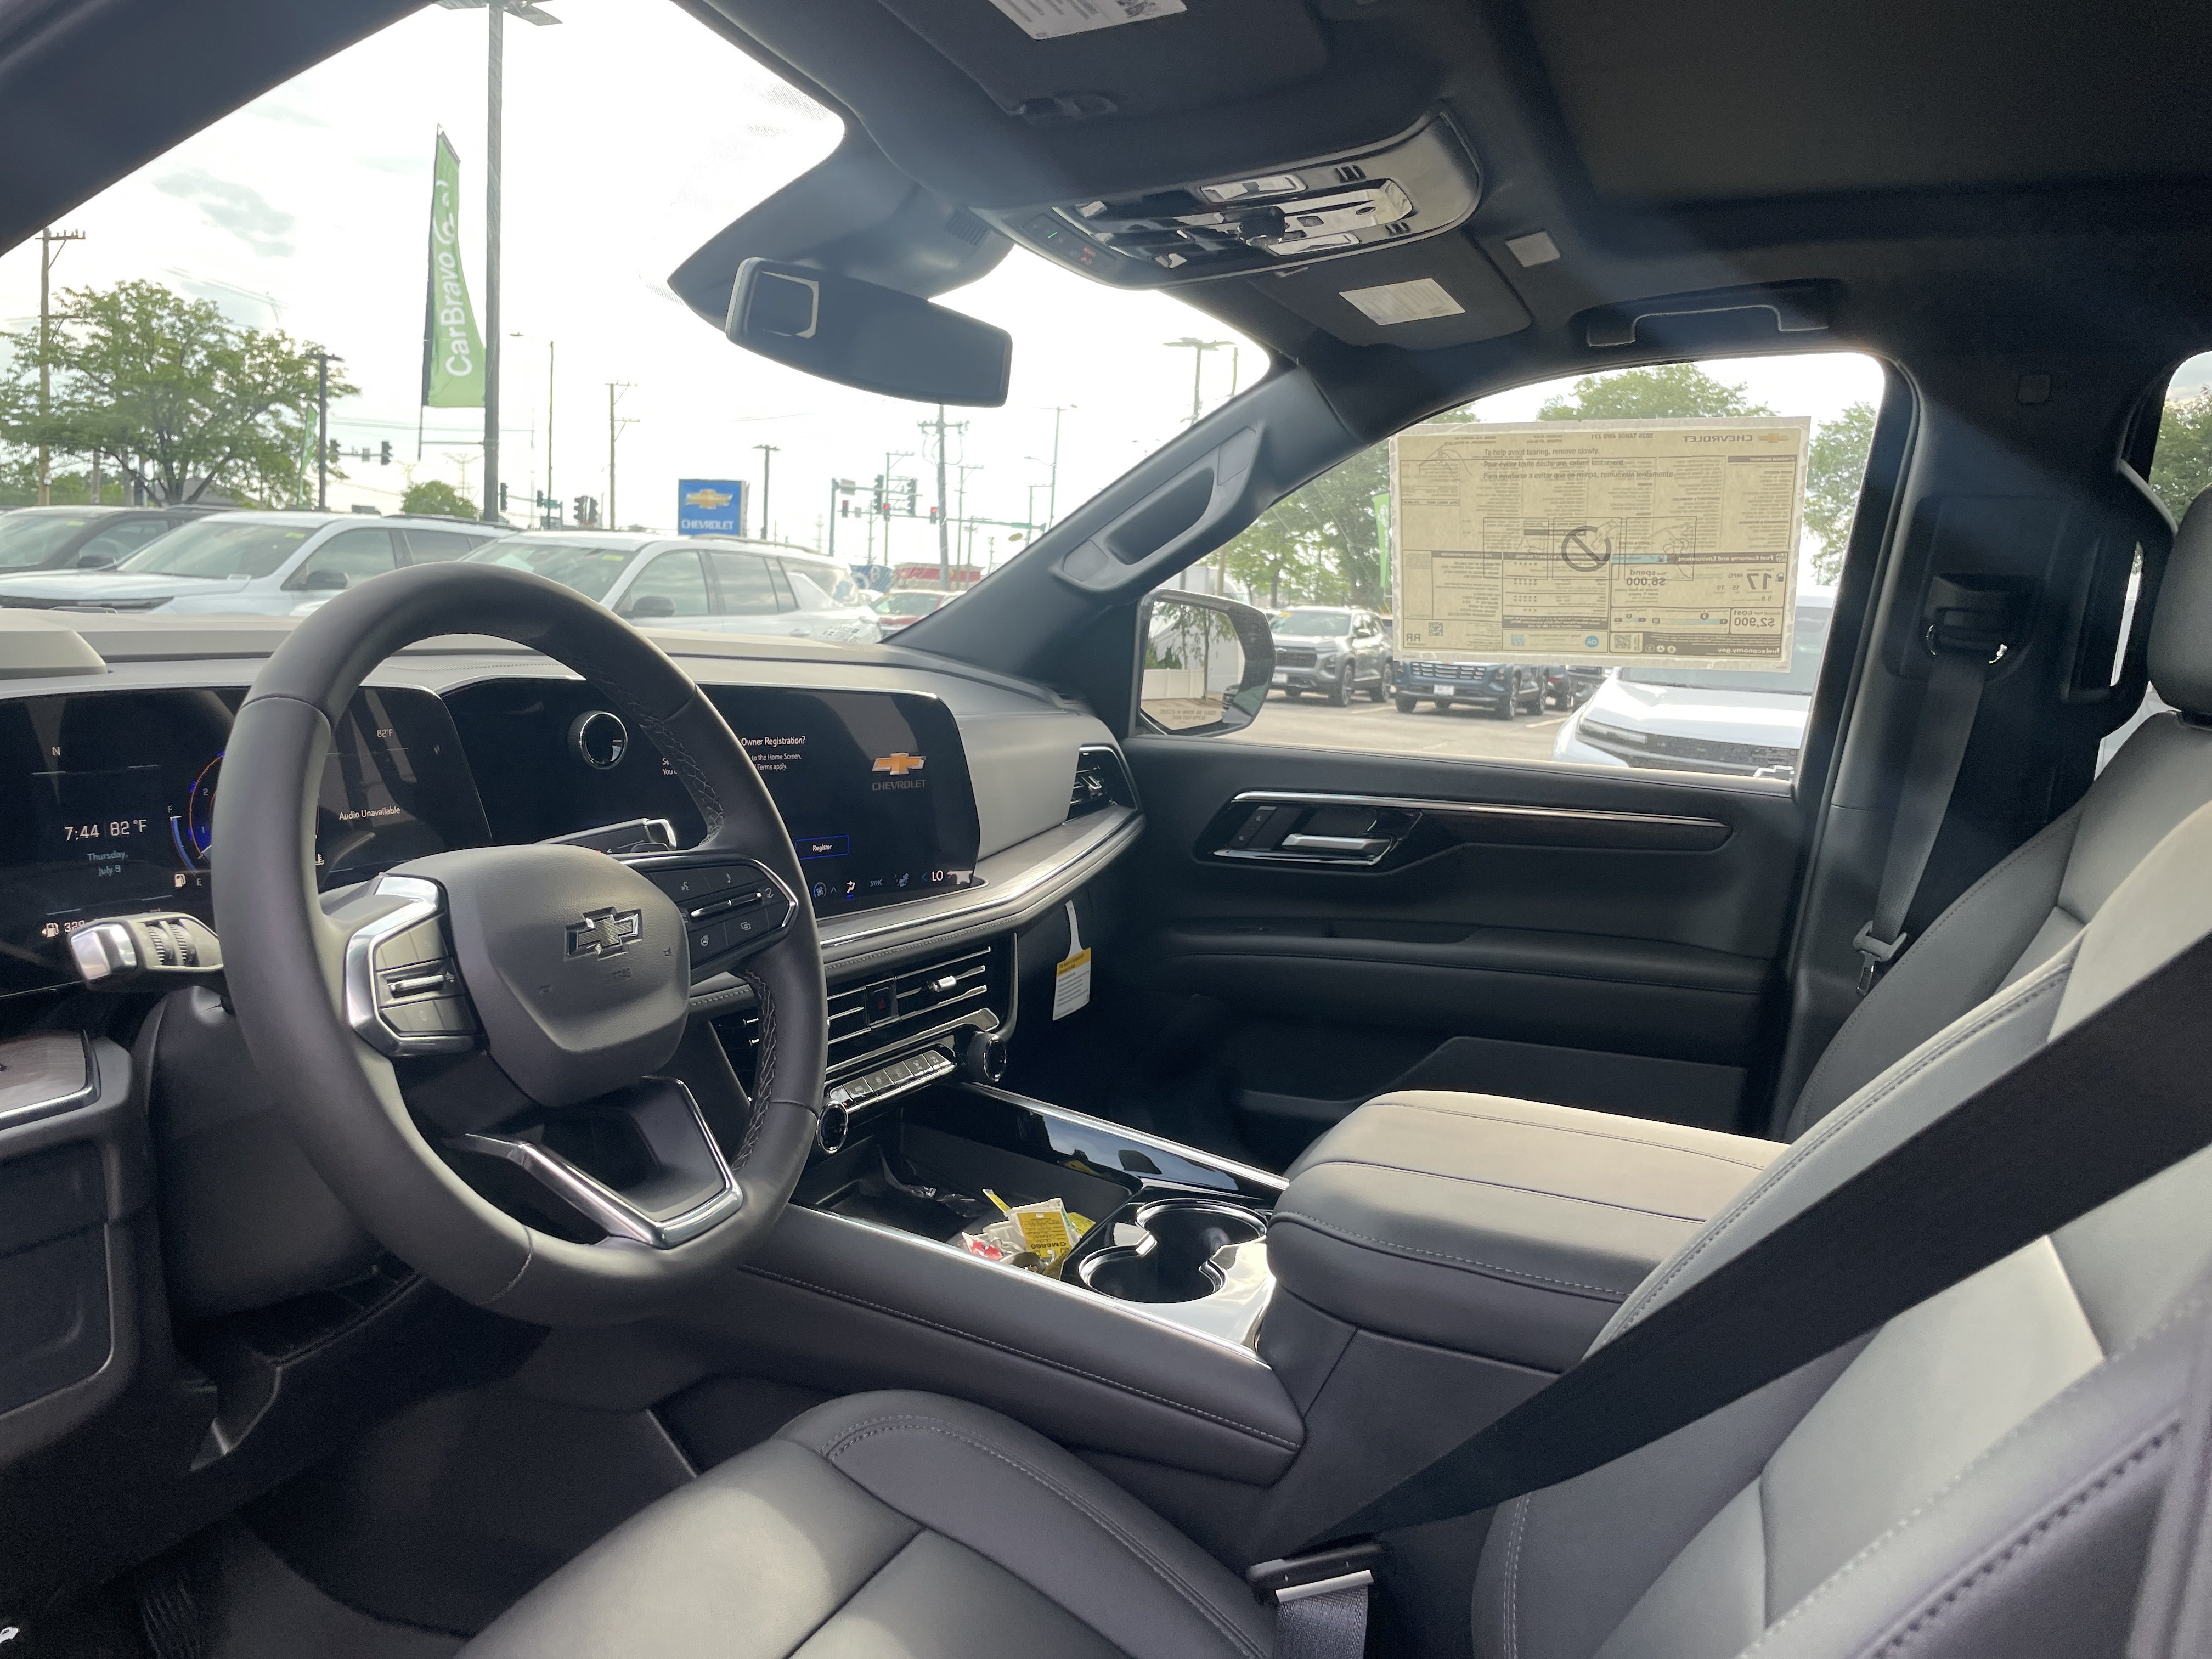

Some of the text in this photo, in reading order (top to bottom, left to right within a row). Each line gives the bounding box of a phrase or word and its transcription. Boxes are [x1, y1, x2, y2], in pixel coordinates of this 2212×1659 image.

[440, 251, 473, 377] CarBravo
[1526, 448, 1550, 456] tearing,
[681, 519, 734, 531] CHEVROLET
[741, 735, 806, 747] Owner Registration?
[52, 746, 61, 756] N
[773, 762, 788, 771] apply.
[872, 779, 927, 791] CHEVROLET
[202, 788, 209, 796] 2
[339, 805, 400, 820] Audio Unavailable
[64, 824, 100, 841] 7:44
[812, 844, 832, 853] Register
[98, 865, 114, 877] July
[930, 871, 942, 883] LO
[196, 878, 202, 887] E
